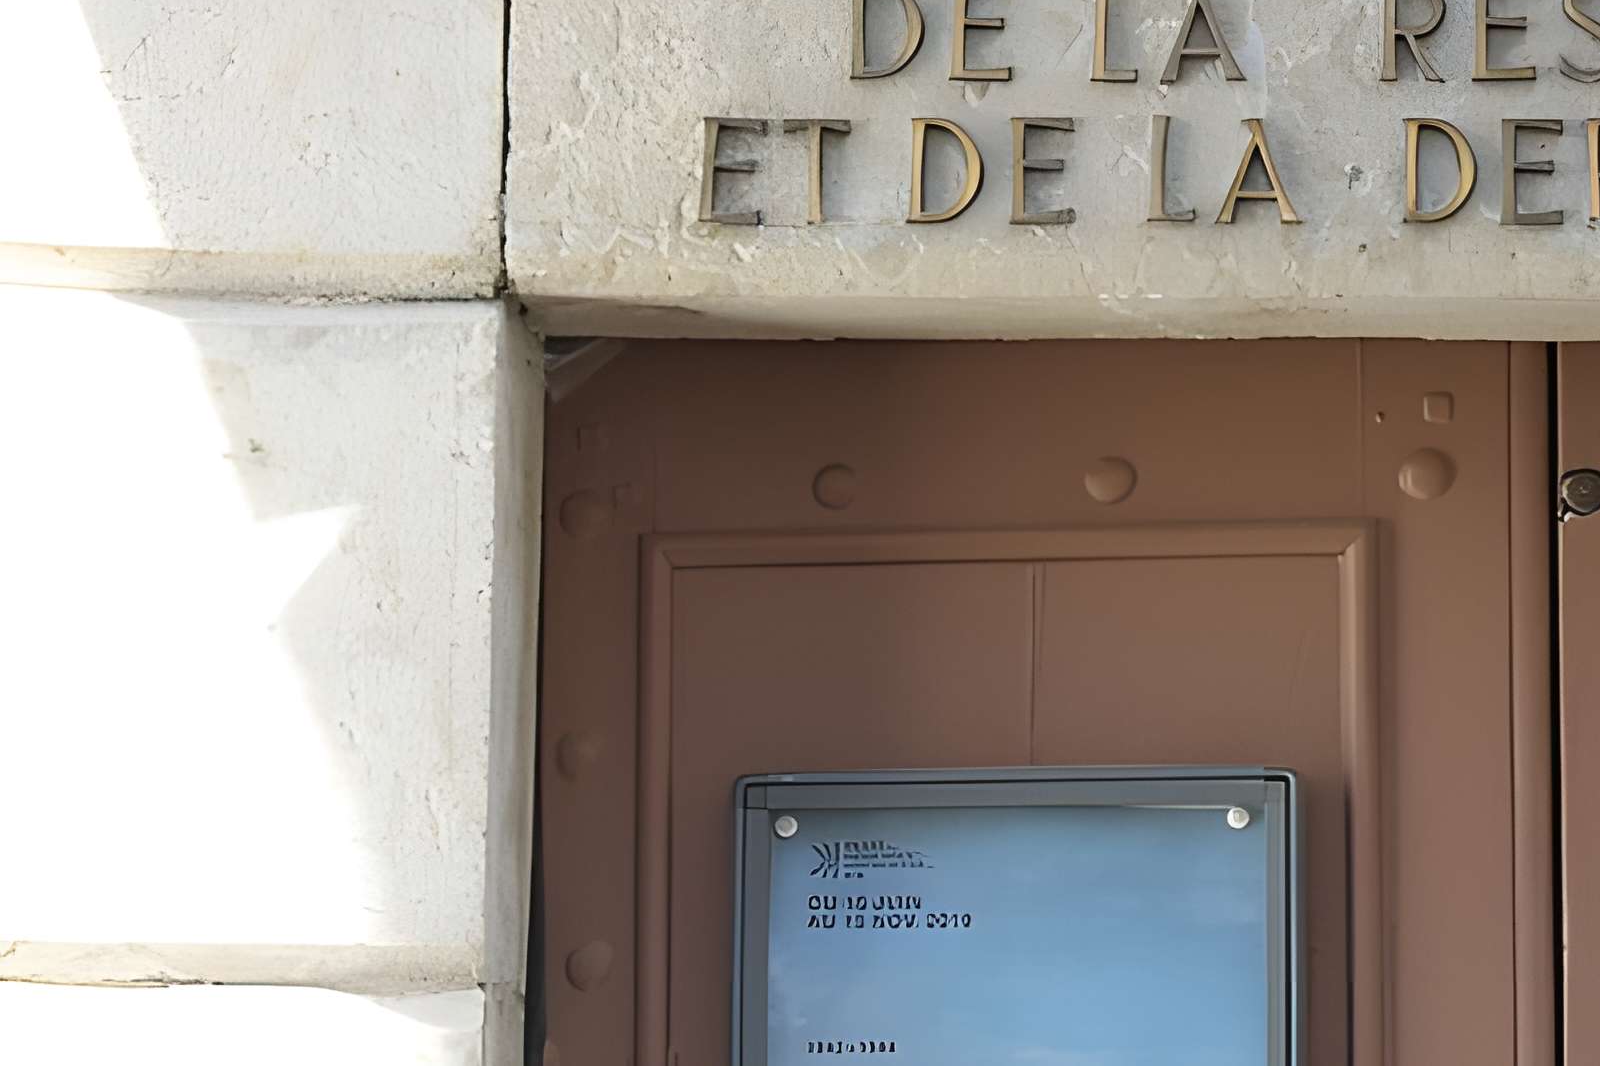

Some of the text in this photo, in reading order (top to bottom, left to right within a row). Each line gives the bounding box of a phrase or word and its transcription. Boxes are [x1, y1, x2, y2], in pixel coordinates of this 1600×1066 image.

[698, 116, 853, 227] ET
[906, 116, 1077, 226] DE
[1146, 114, 1303, 225] LA
